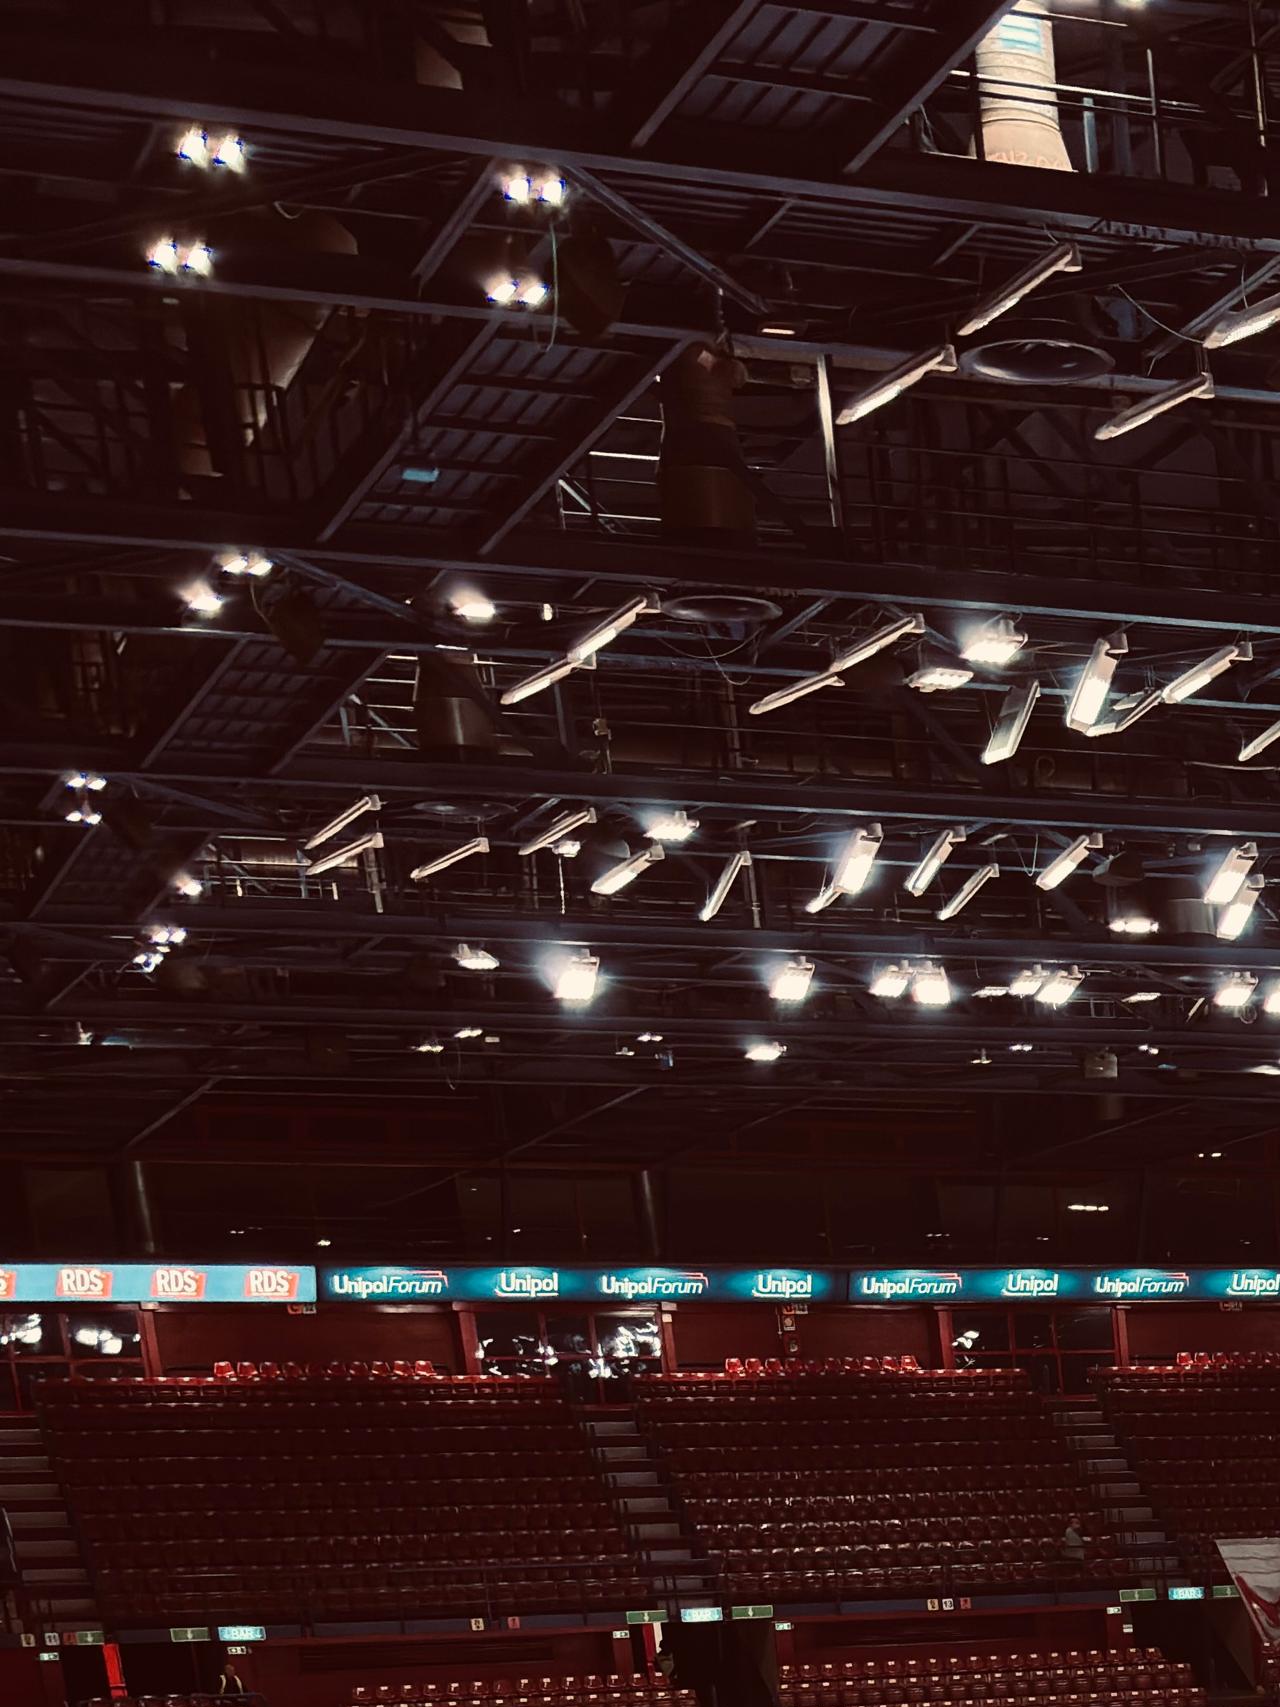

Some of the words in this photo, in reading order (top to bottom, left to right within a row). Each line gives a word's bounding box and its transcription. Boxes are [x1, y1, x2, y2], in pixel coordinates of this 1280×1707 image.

[61, 1269, 104, 1292] RDS
[156, 1269, 198, 1293] RDS
[249, 1270, 290, 1293] RDS
[333, 1274, 442, 1298] UnipolForum
[500, 1272, 559, 1297] Unipol
[601, 1275, 704, 1298] UnipolForum
[757, 1274, 812, 1297] Unipol
[862, 1276, 956, 1298] UnipolForum
[1007, 1273, 1059, 1296] Unipol
[1095, 1275, 1184, 1297] UnipolForum
[1232, 1273, 1280, 1296] Unipol
